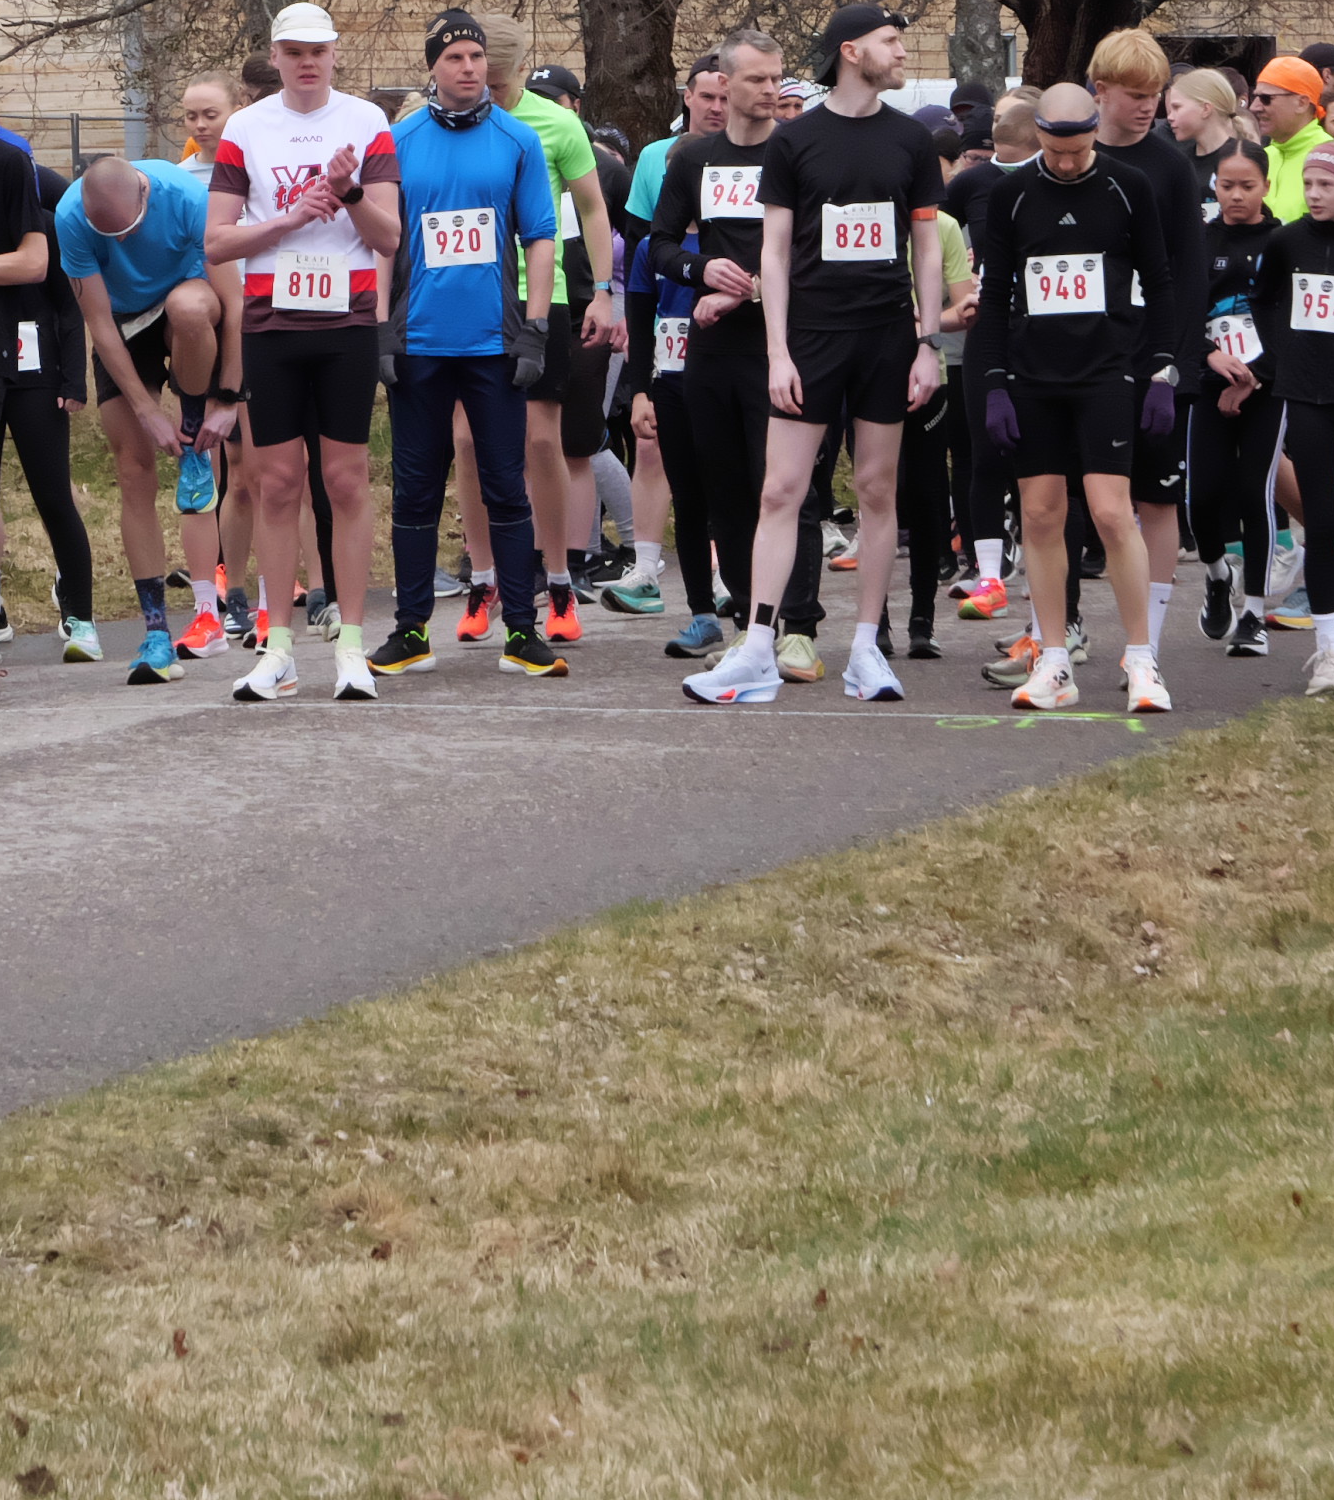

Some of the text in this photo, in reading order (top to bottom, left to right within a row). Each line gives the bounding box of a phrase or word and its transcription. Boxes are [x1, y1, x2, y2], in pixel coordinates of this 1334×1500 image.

[713, 183, 756, 206] 942
[436, 227, 481, 255] 920
[835, 222, 882, 248] 828
[288, 271, 332, 299] 810
[1039, 274, 1087, 302] 948
